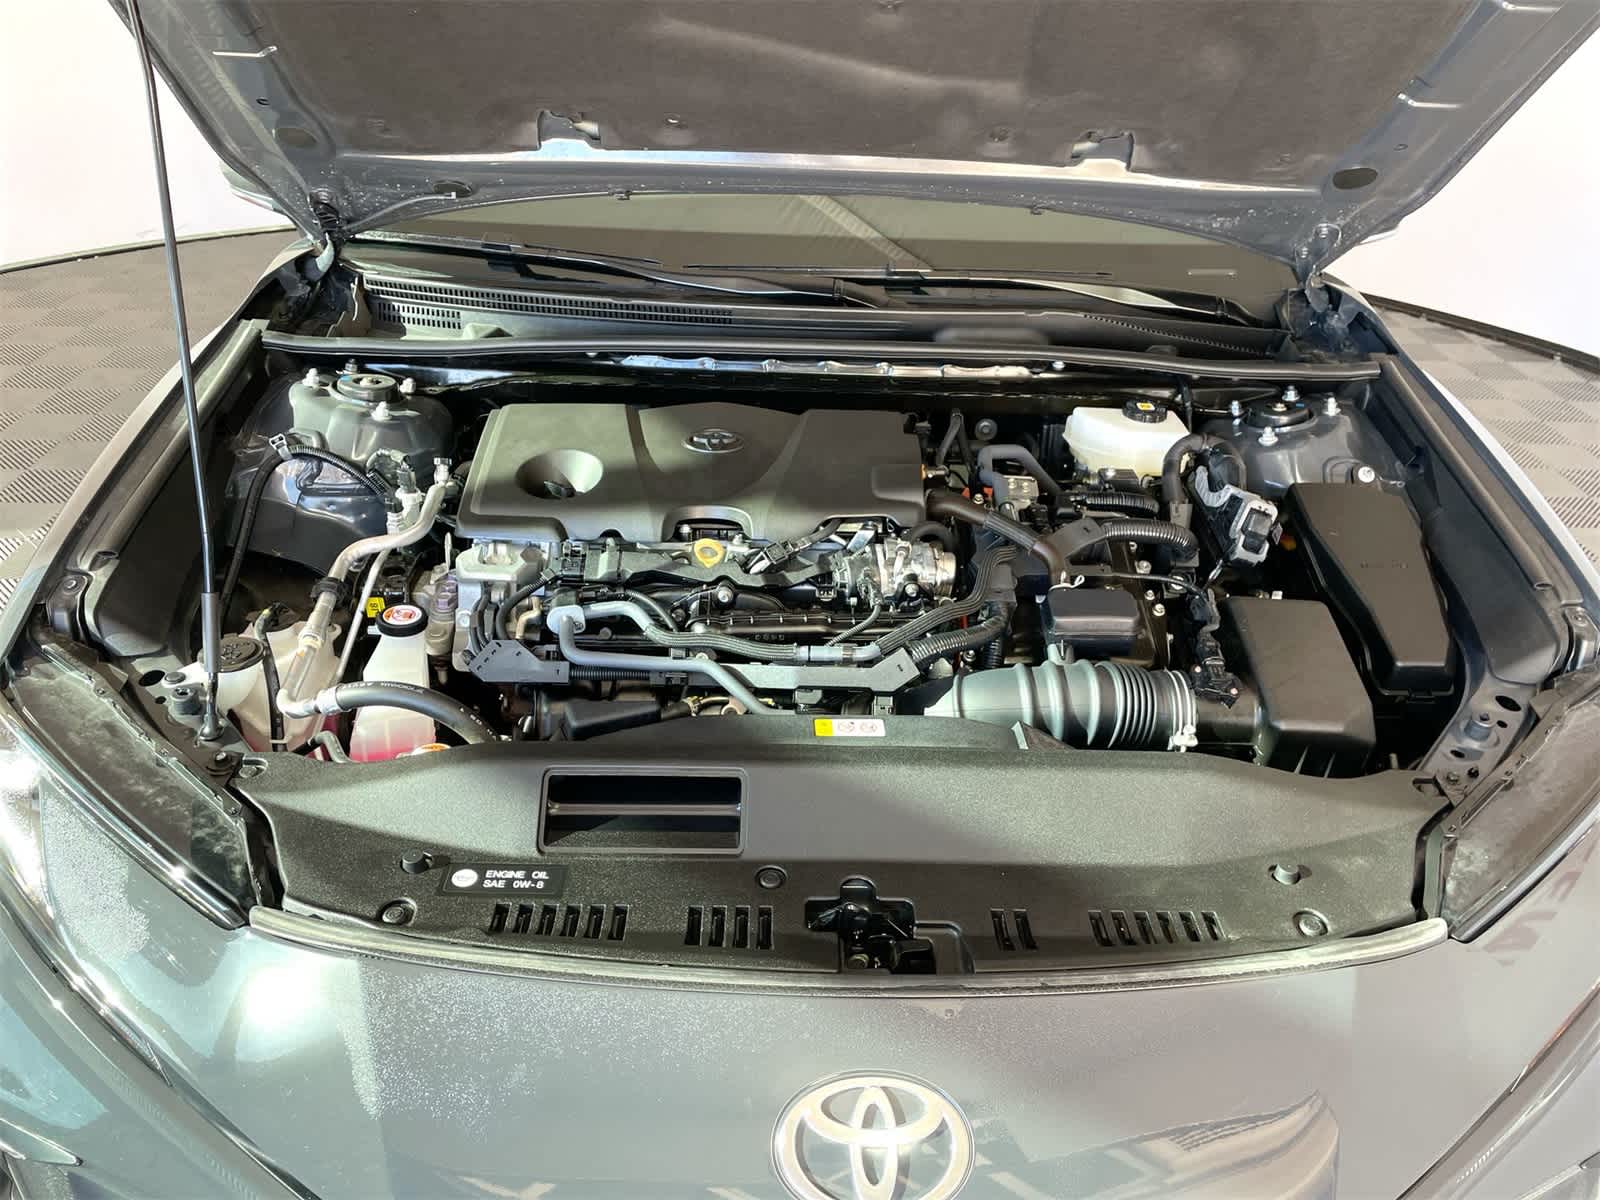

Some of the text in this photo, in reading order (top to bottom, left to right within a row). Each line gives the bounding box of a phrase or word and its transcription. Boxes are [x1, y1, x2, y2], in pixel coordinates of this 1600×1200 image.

[485, 870, 526, 879] ENGINE
[531, 871, 549, 879] OIL
[482, 880, 545, 889] SAE 0W-8
